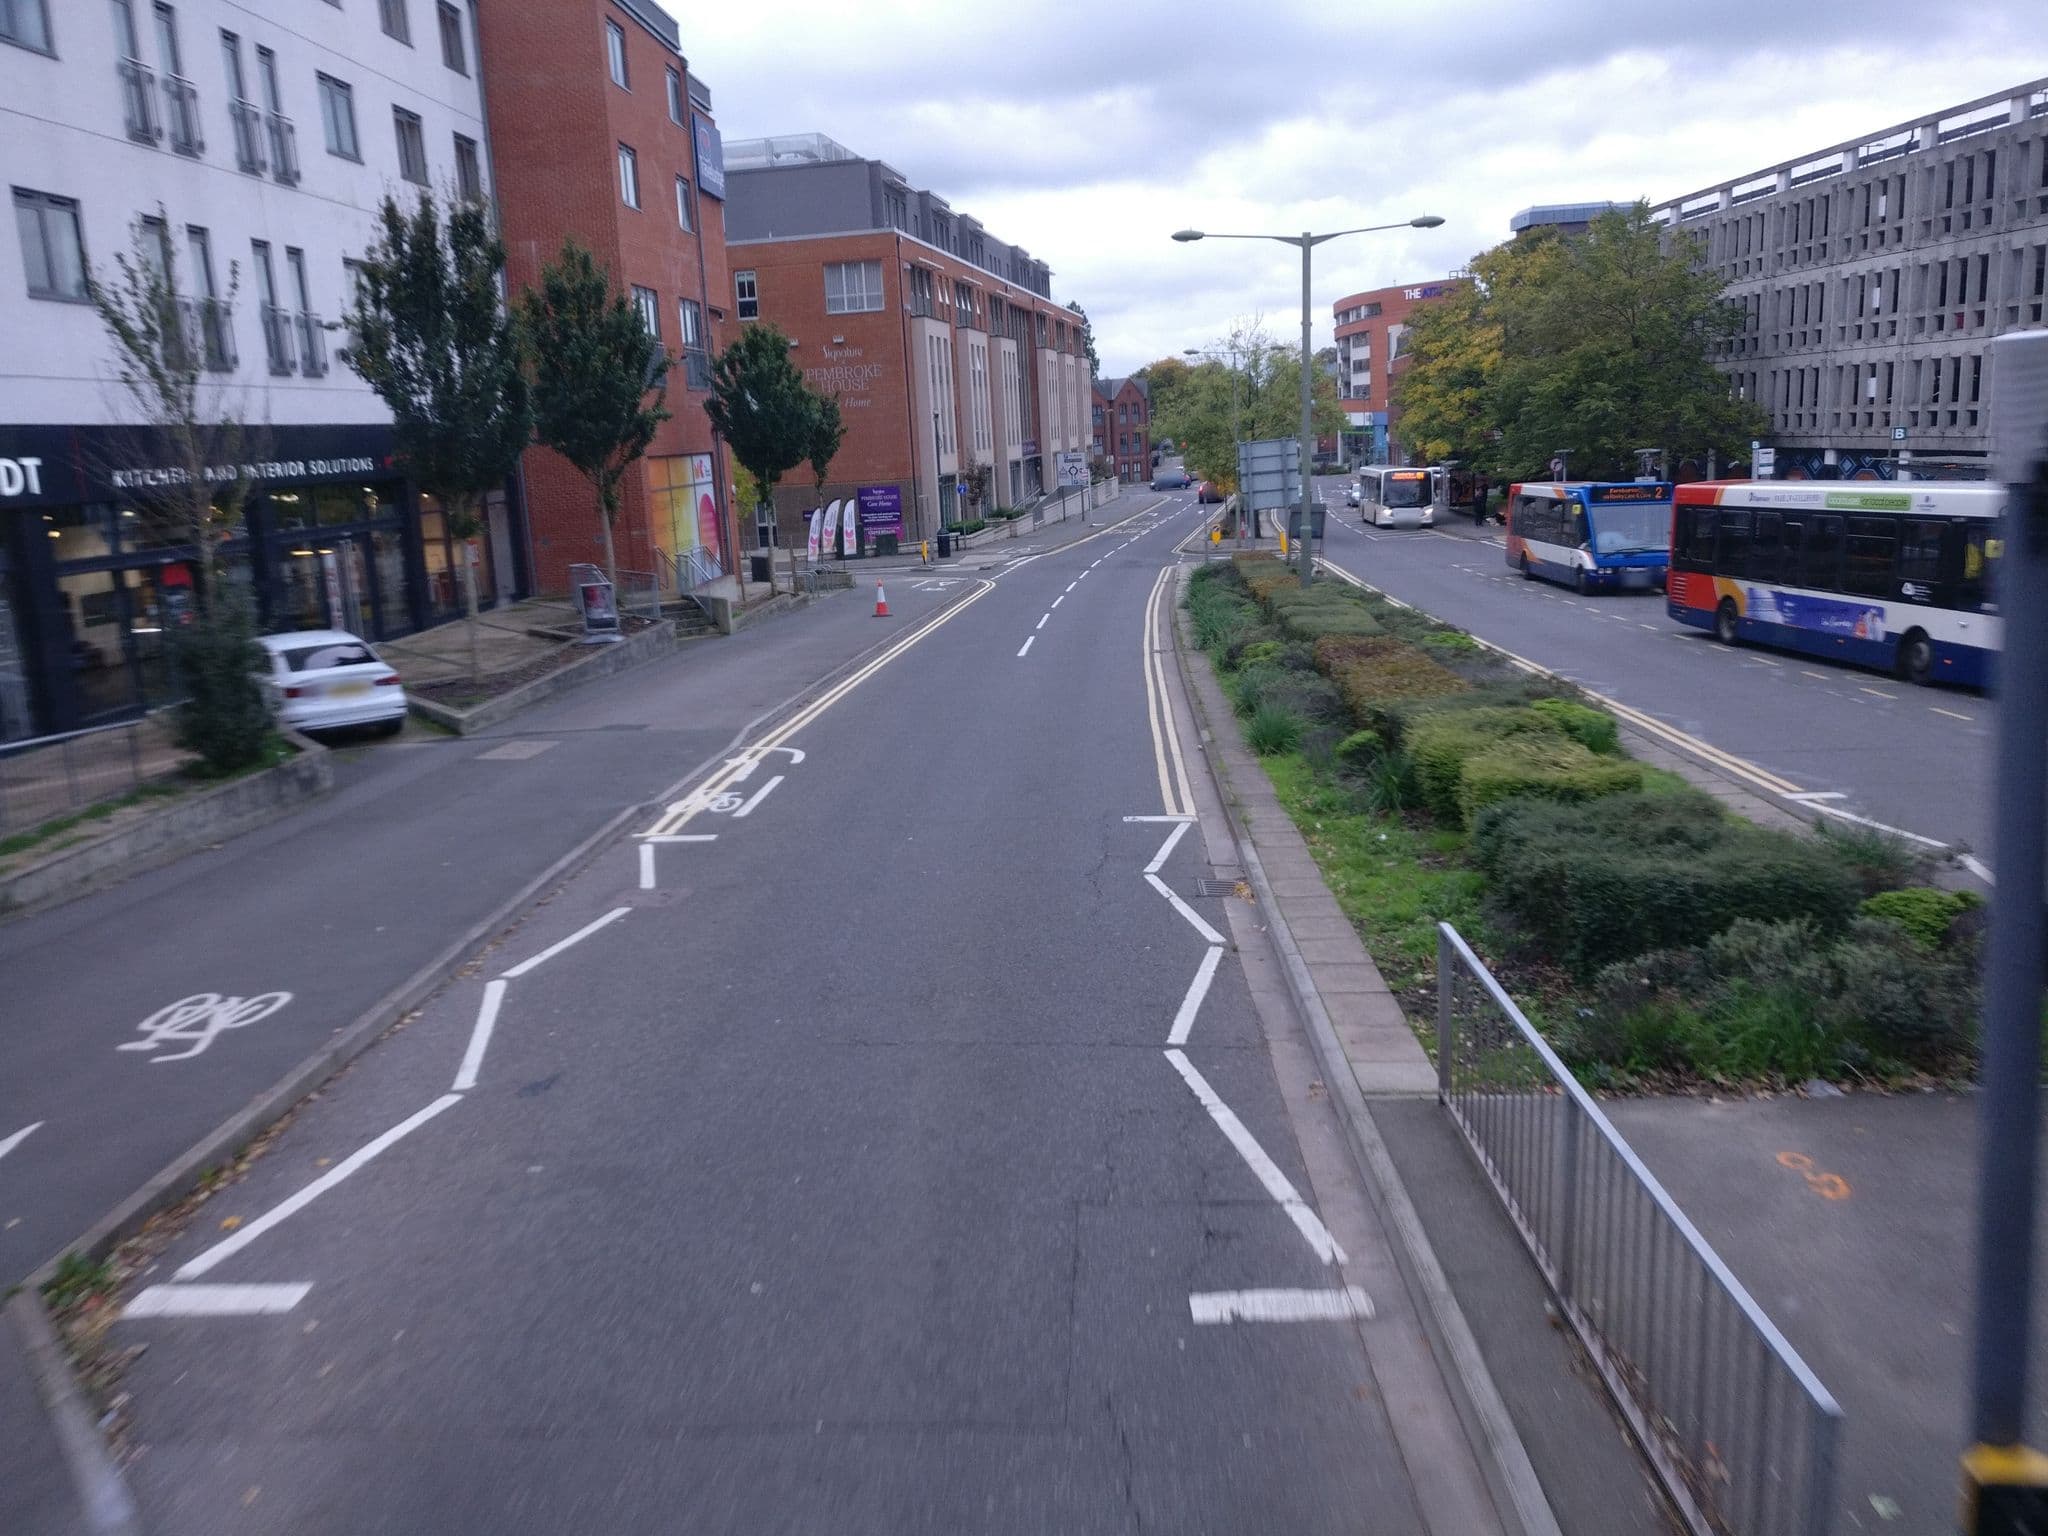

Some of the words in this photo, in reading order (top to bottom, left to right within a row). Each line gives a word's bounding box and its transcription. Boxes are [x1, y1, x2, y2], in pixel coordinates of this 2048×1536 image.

[1403, 287, 1422, 301] THE
[806, 364, 882, 381] PEMBROKE
[821, 378, 870, 393] HOUSE
[308, 456, 374, 476] SOLUTIONS
[0, 456, 41, 496] DT
[1655, 486, 1664, 499] 2
